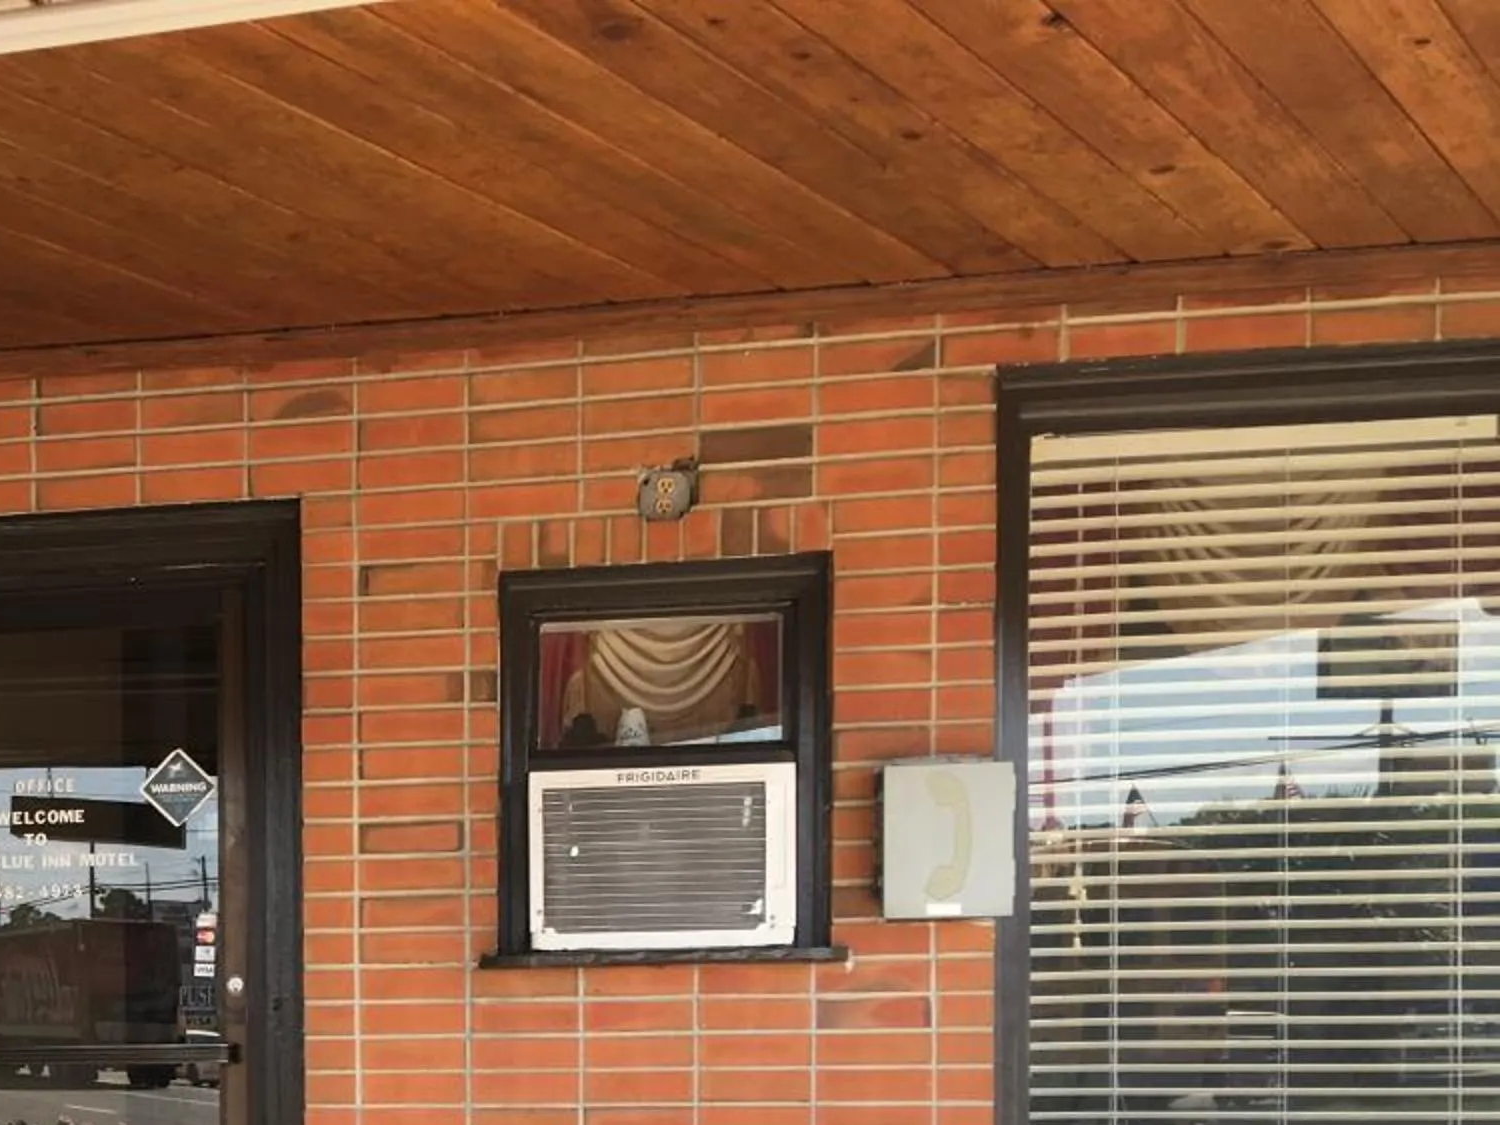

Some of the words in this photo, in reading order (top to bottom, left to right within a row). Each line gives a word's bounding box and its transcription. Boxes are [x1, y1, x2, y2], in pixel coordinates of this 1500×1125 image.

[616, 769, 701, 784] FRIGIDAIRE
[15, 777, 76, 794] OFFICE
[150, 782, 207, 794] WARNING
[23, 832, 48, 847] TO
[41, 852, 71, 868] INN
[79, 852, 138, 868] MOTEL
